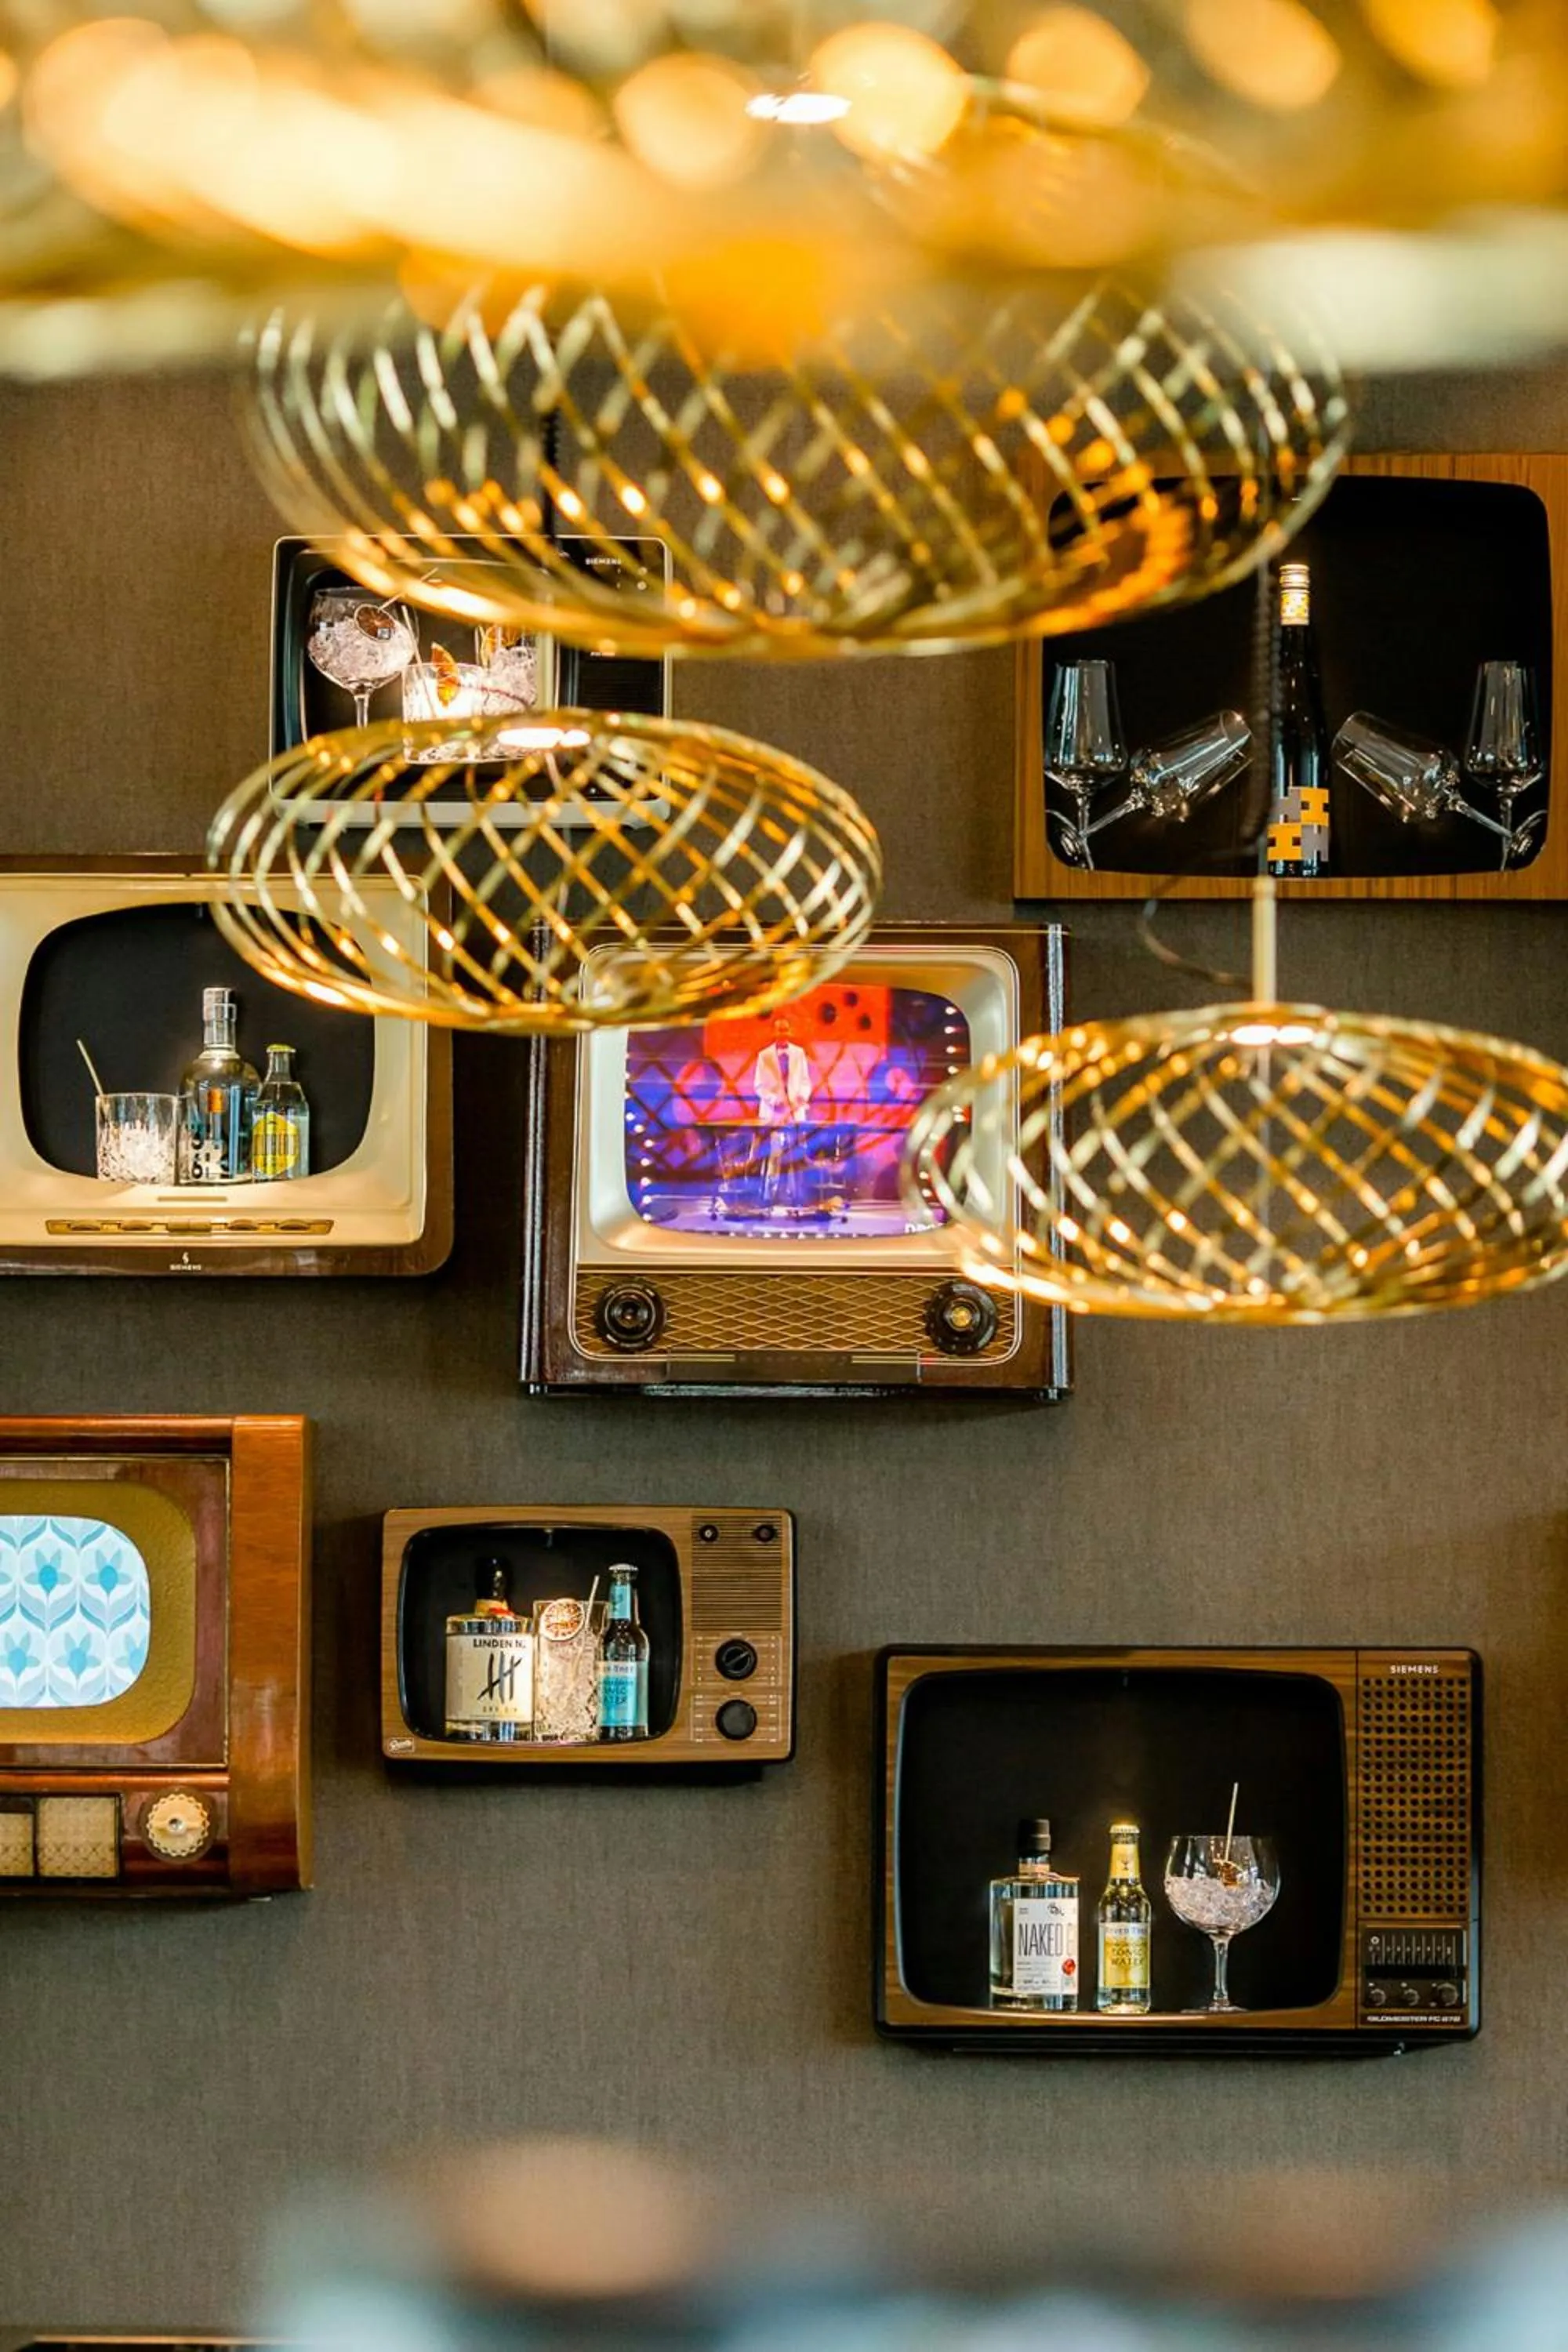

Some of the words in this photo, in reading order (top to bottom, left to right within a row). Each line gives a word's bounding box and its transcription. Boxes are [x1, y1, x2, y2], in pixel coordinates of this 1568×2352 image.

[473, 1639, 513, 1648] LINDEN
[1390, 1664, 1439, 1674] SIEMENS
[1018, 1922, 1064, 1957] NAKED
